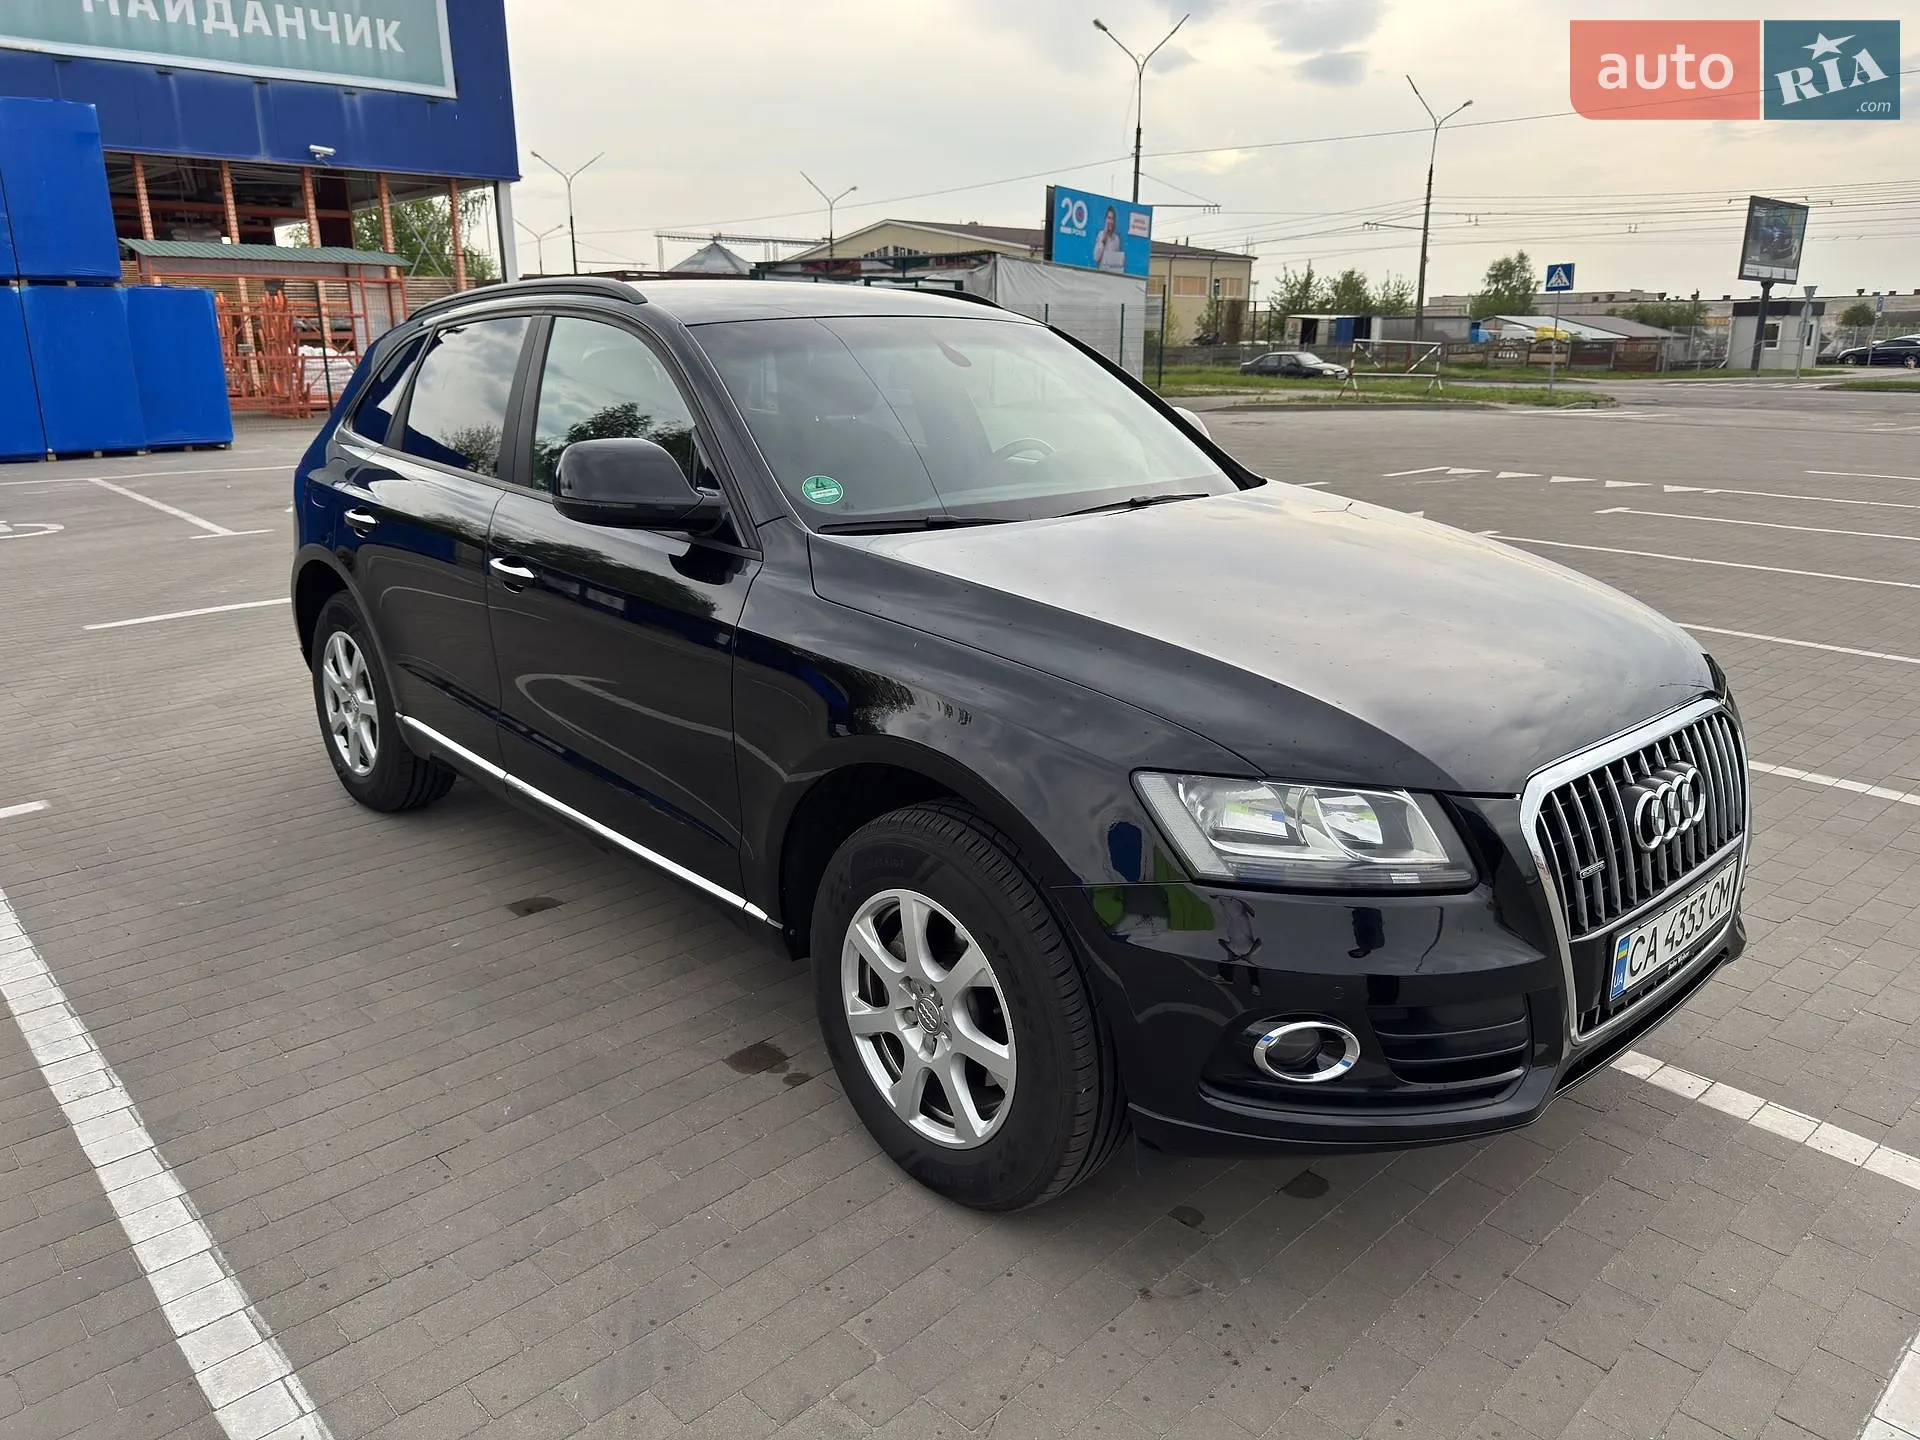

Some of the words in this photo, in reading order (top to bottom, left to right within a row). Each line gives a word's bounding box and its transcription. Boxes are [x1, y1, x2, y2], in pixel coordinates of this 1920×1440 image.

[1061, 197, 1088, 230] 20
[1630, 926, 1658, 977] CA
[1664, 890, 1707, 953] 4353
[1709, 870, 1733, 920] CM
[1613, 972, 1624, 988] UA
